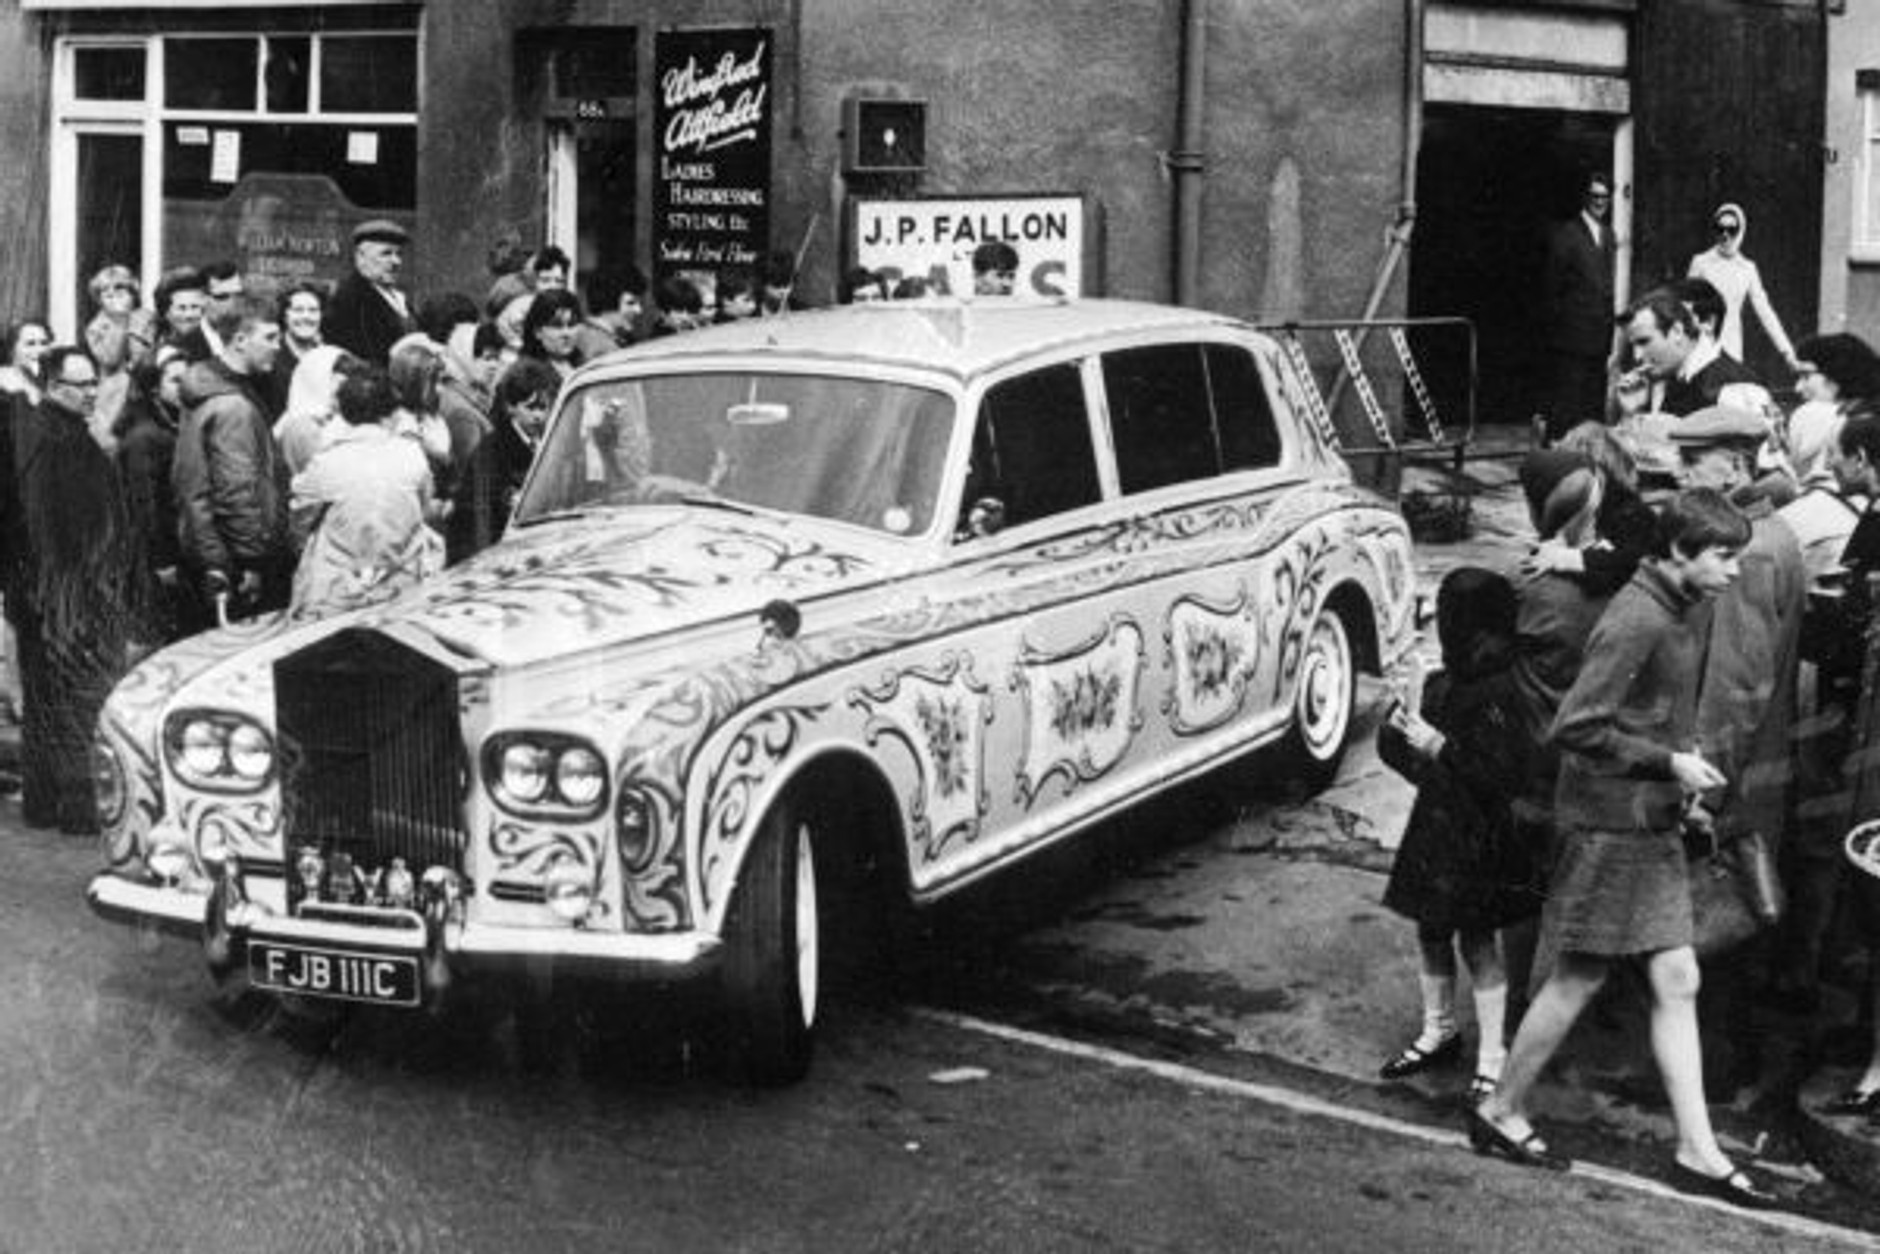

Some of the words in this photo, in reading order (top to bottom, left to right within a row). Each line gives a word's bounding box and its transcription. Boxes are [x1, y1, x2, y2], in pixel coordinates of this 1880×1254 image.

[661, 156, 715, 180] LADIES
[670, 182, 763, 205] HAIRDRESSING
[668, 213, 726, 230] STYLING
[933, 213, 1068, 244] FALLON
[266, 950, 331, 989] FJB
